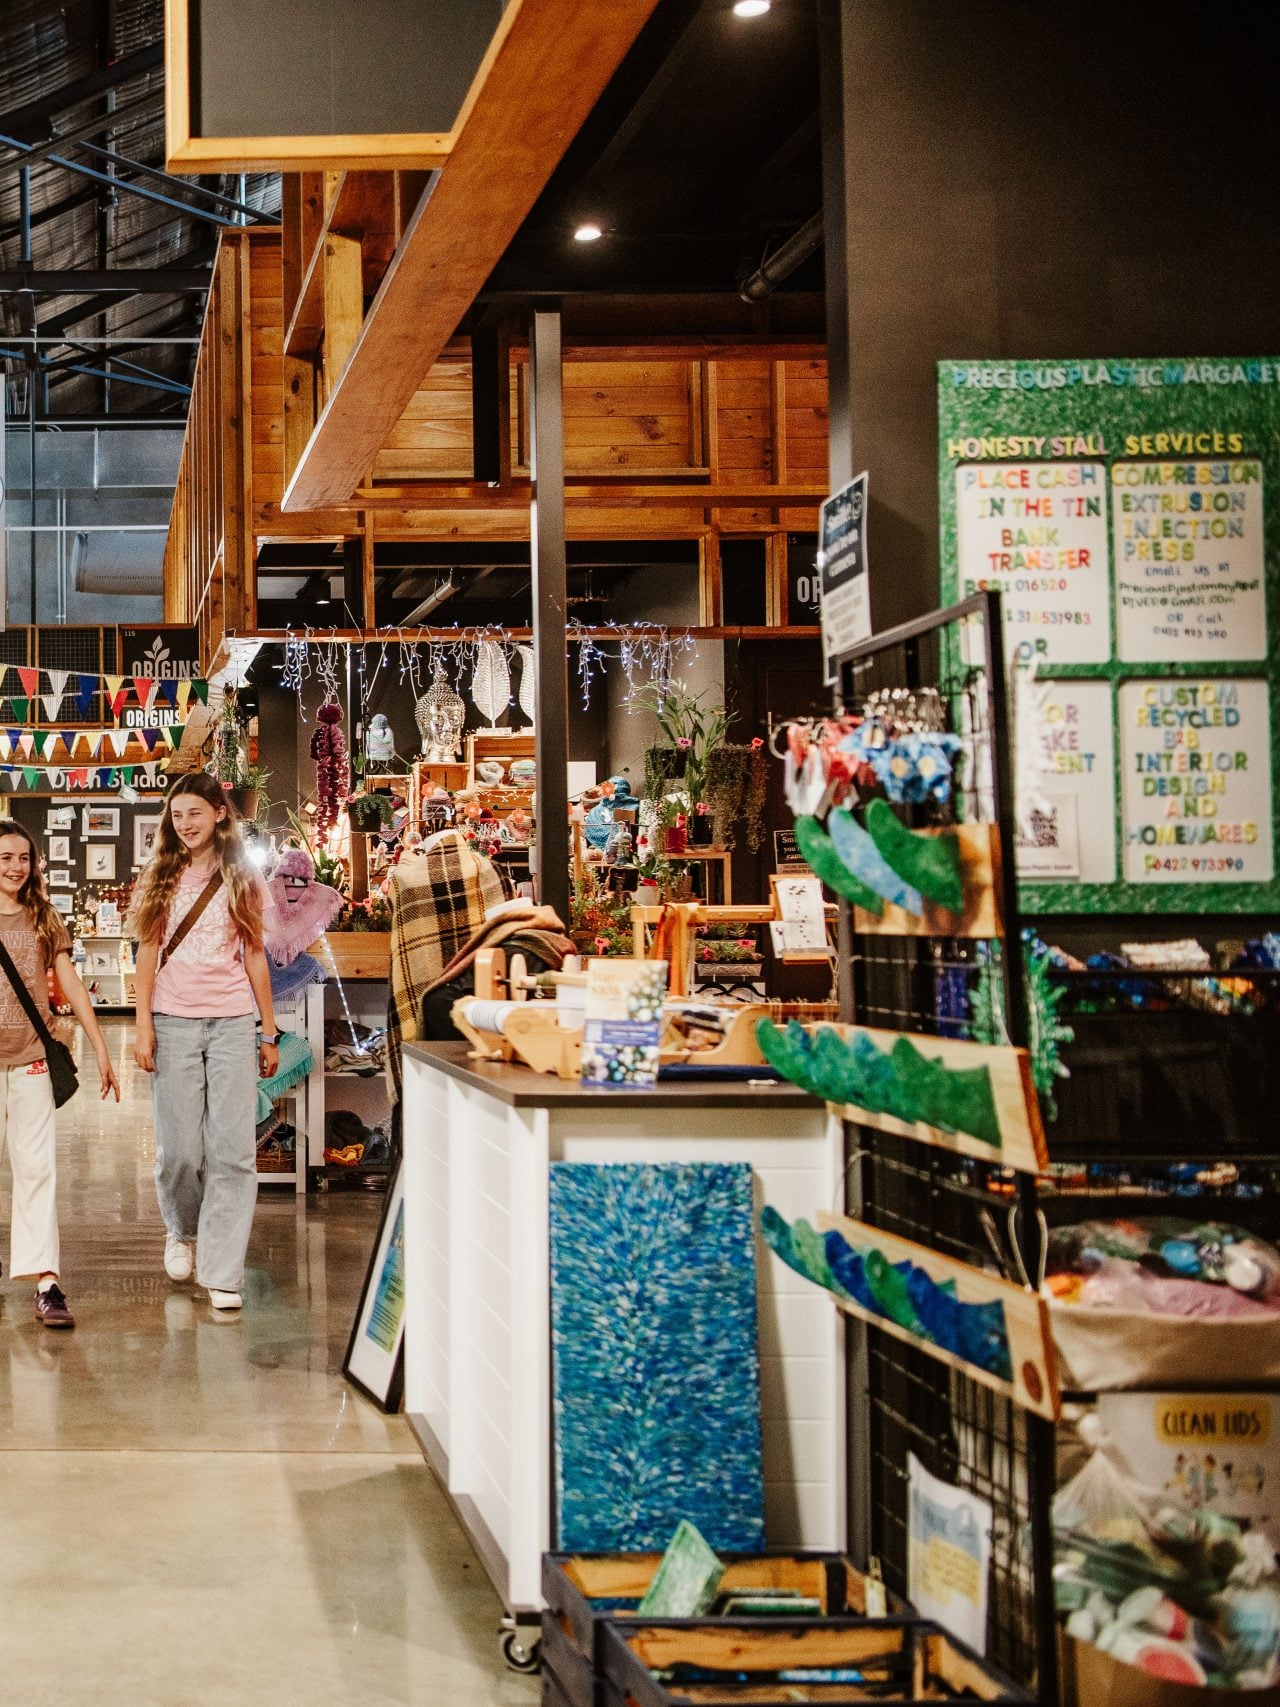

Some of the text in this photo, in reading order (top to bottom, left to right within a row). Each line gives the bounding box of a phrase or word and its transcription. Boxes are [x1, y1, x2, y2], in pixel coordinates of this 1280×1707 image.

[947, 433, 1110, 459] HONESTY STALL
[1125, 431, 1244, 456] SERVICES
[964, 463, 1097, 490] PLACE CASH
[1111, 460, 1260, 487] COMPRESSION
[978, 496, 1101, 518] IN THE TIN
[1121, 491, 1246, 513] EXTRUSION
[1001, 527, 1060, 547] BANK
[1122, 517, 1245, 540] INJECTION
[987, 549, 1091, 572] TRANSFER
[1124, 540, 1195, 563] PRESS
[1015, 578, 1067, 592] 016520
[1018, 638, 1048, 661] OR
[132, 660, 200, 680] ORIGINS
[1143, 683, 1239, 707] CUSTOM
[1136, 706, 1241, 729] RECYCLED
[1164, 729, 1199, 750] B2B
[1135, 751, 1248, 773] INTERIOR
[1143, 774, 1226, 797] DESIGN
[1165, 798, 1218, 818] AND
[1126, 822, 1258, 846] HOMEWARES
[1163, 1409, 1262, 1437] CLEAN LIDS
